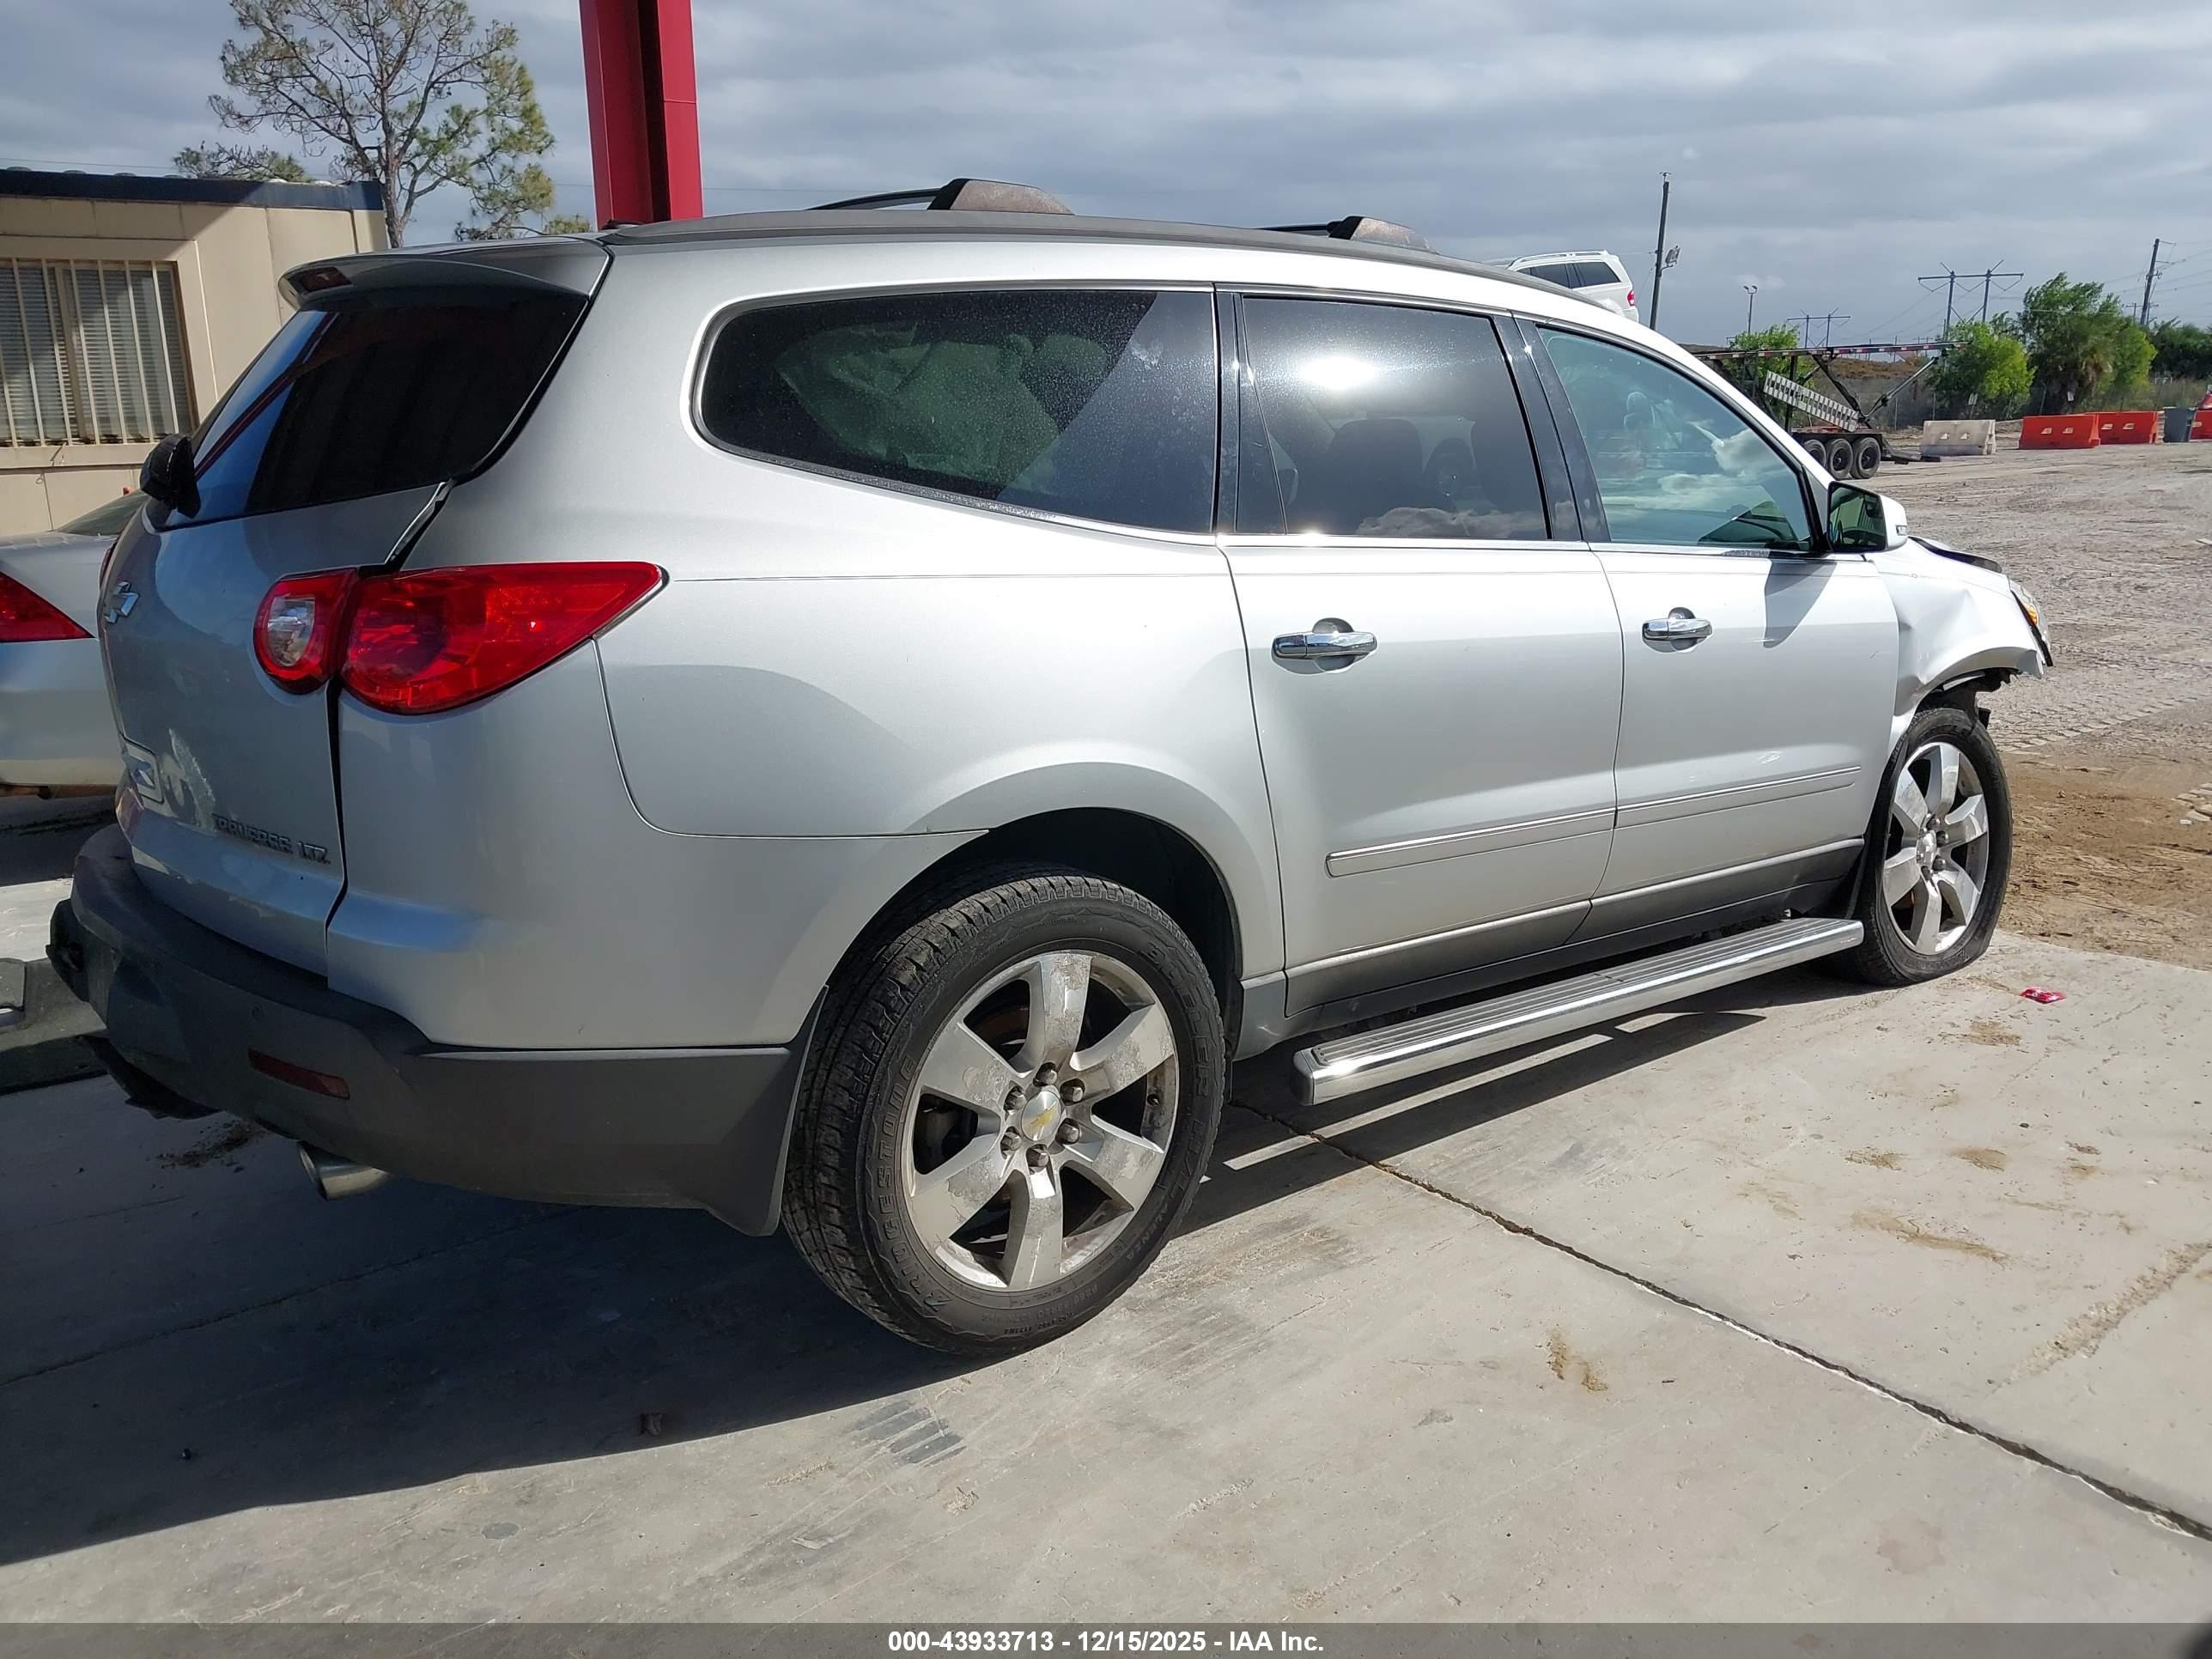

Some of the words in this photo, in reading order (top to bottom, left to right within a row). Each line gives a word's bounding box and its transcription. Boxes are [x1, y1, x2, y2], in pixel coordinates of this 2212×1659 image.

[212, 813, 293, 854] TRAVERSE
[297, 841, 331, 865] LTZ
[876, 1054, 953, 1314] BRIDGESTONE
